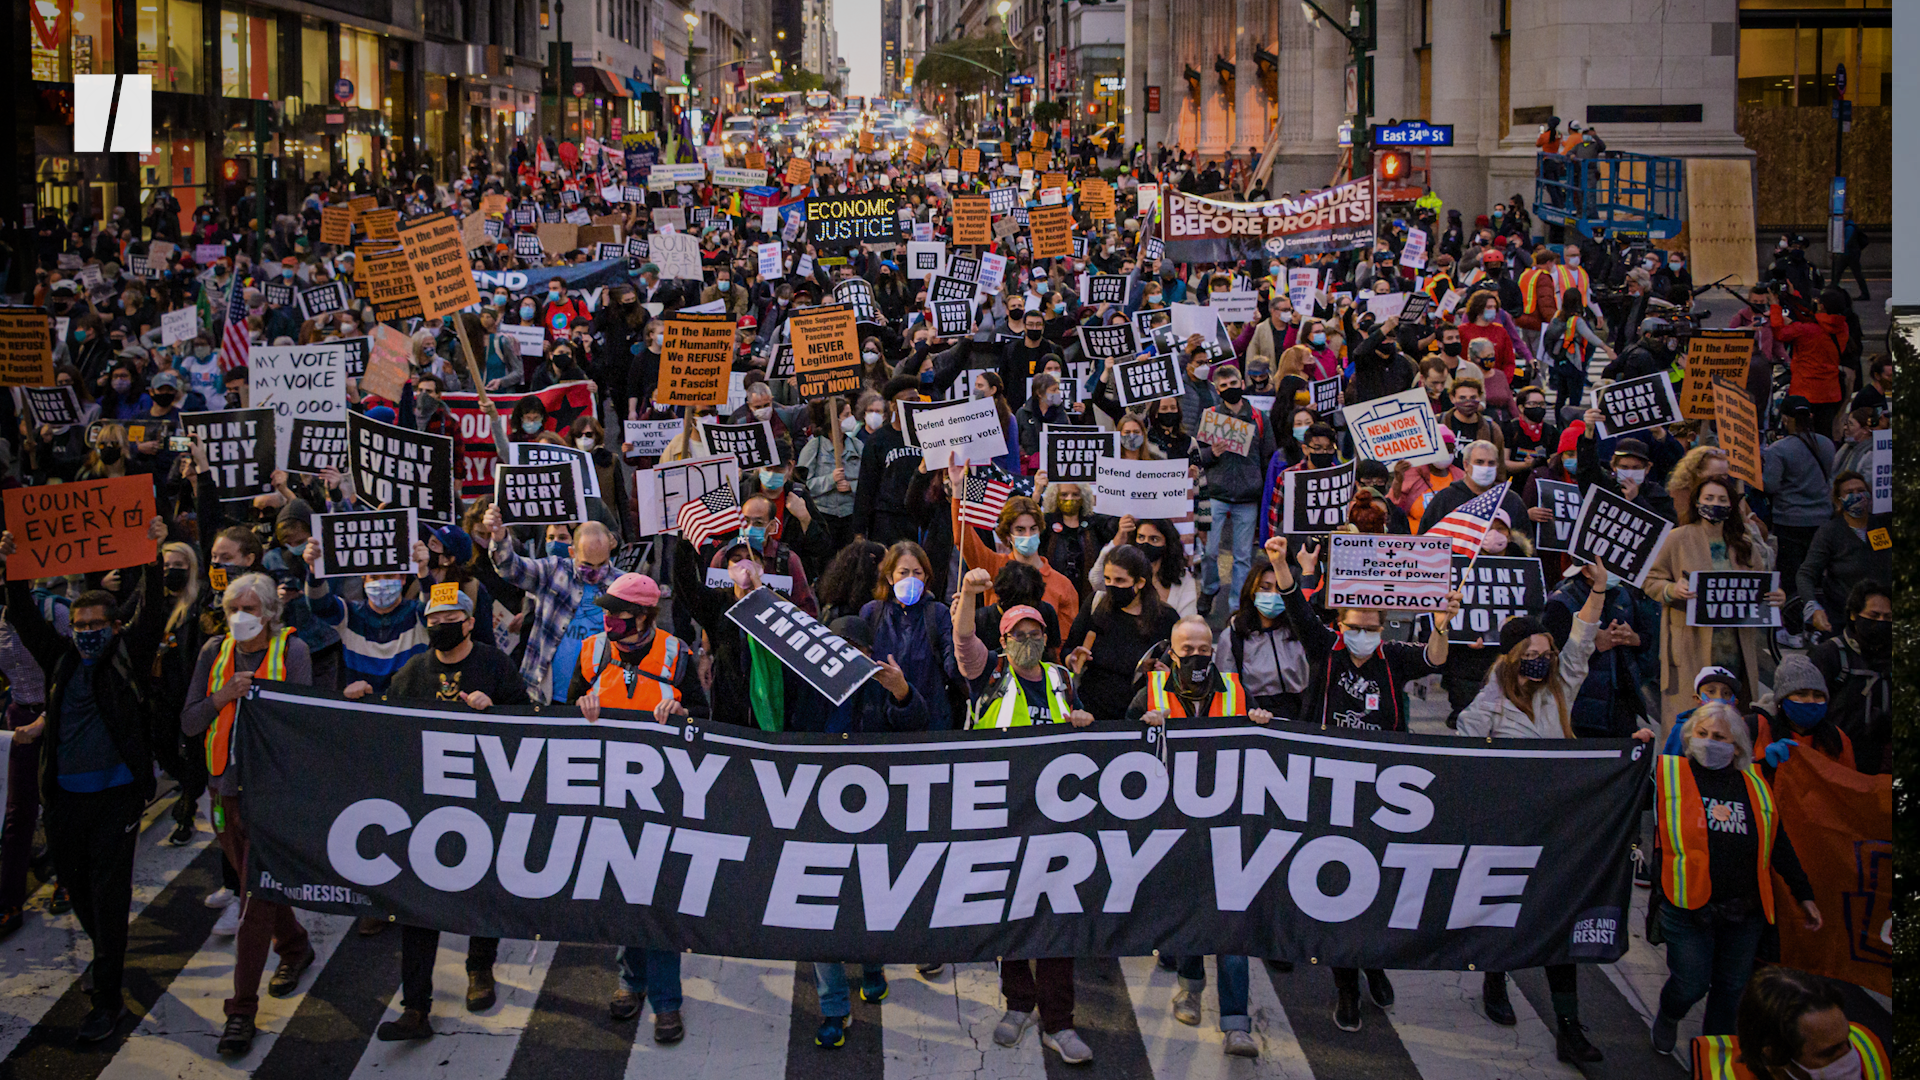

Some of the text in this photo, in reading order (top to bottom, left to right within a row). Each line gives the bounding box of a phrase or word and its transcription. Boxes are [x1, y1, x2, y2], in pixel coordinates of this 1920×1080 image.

[1383, 129, 1444, 142] East 34th St
[1283, 180, 1371, 216] NATURE
[808, 198, 895, 220] ECONOMIC
[1170, 201, 1371, 235] BEFORE PROFITS!
[404, 224, 455, 245] In the Name
[815, 217, 894, 241] JUSTICE
[653, 236, 698, 252] COUNT
[1286, 235, 1330, 246] Communist
[409, 237, 460, 259] of Humanity,
[415, 249, 462, 272] We REFUSE
[650, 252, 697, 262] EVERY
[955, 259, 975, 268] COUNT
[368, 262, 388, 272] STOP
[658, 264, 699, 276] VOTE
[954, 266, 974, 274] EVERY
[424, 265, 463, 284] to Accept
[370, 280, 391, 289] TAKE
[372, 284, 416, 298] STREETS
[437, 278, 466, 295] Fascist
[940, 280, 971, 292] COUNT
[1093, 285, 1120, 293] EVERY
[938, 287, 968, 299] EVERY
[434, 292, 470, 312] America!
[940, 304, 966, 312] COUNT
[164, 312, 187, 325] COUNT
[794, 315, 852, 326] White Supremacy,
[941, 312, 966, 321] EVERY
[16, 319, 44, 328] Name
[801, 324, 833, 333] Theocracy
[668, 326, 731, 337] In the Name
[805, 332, 832, 341] Fascism
[1089, 329, 1125, 337] COUNT
[8, 342, 45, 350] REFUSE
[680, 340, 731, 351] Humanity,
[808, 341, 844, 354] NEVER
[1091, 336, 1126, 346] EVERY
[1705, 343, 1749, 352] the Name
[9, 353, 42, 361] Accept
[255, 351, 338, 369] MY VOTE
[668, 352, 727, 362] We REFUSE
[801, 352, 853, 367] Legitimate
[1703, 356, 1748, 366] Humanity,
[8, 363, 42, 372] Fascist
[672, 366, 720, 377] to Accept
[1127, 361, 1165, 375] COUNT
[1691, 368, 1705, 377] We
[2, 374, 43, 382] America!
[255, 371, 337, 390] MY VOICE
[804, 369, 853, 382] Trump/Pence
[1129, 370, 1167, 386] EVERY
[681, 379, 718, 388] Fascist
[800, 376, 860, 397] OUT NOW!
[669, 391, 716, 401] America!
[1604, 382, 1653, 402] COUNT
[1607, 393, 1656, 414] EVERY
[917, 409, 994, 431] Defend democracy
[1205, 411, 1249, 435] BLACK
[1367, 416, 1418, 436] NEW YORK
[712, 430, 754, 440] COUNT
[922, 426, 1000, 450] Count every vote!
[1203, 422, 1246, 444] LIVES
[1372, 428, 1417, 444] COMMUNITIES
[359, 428, 433, 462] COUNT
[714, 440, 757, 452] EVERY
[1057, 440, 1104, 449] COUNT
[1374, 435, 1426, 457] CHANGE
[1057, 450, 1103, 461] EVERY
[360, 446, 432, 484] EVERY
[505, 471, 561, 486] COUNT
[1098, 467, 1186, 479] Defend democracy
[360, 470, 434, 510] VOTE
[506, 484, 561, 500] EVERY
[1098, 486, 1186, 499] Count every vote!
[22, 485, 108, 515] COUNT
[26, 506, 116, 541] EVERY
[1598, 501, 1653, 535] COUNT
[334, 518, 396, 534] COUNT
[1590, 514, 1645, 550] EVERY
[334, 531, 396, 548] EVERY
[1333, 538, 1450, 549] Count every vote
[1874, 539, 1890, 547] NOW
[32, 535, 117, 568] VOTE
[1363, 559, 1418, 568] Peaceful
[1335, 568, 1446, 579] transfer of power
[1707, 578, 1761, 588] COUNT
[433, 594, 456, 603] NOW
[434, 588, 453, 596] OUT
[1706, 589, 1758, 601] EVERY
[1334, 594, 1444, 607] DEMOCRACY
[755, 607, 844, 678] COUNT
[421, 731, 1436, 834] EVERY VOTE COUNTS
[327, 798, 1544, 931] COUNT EVERY VOTE
[1574, 918, 1617, 930] RISE AND
[1573, 930, 1615, 945] RESIST
